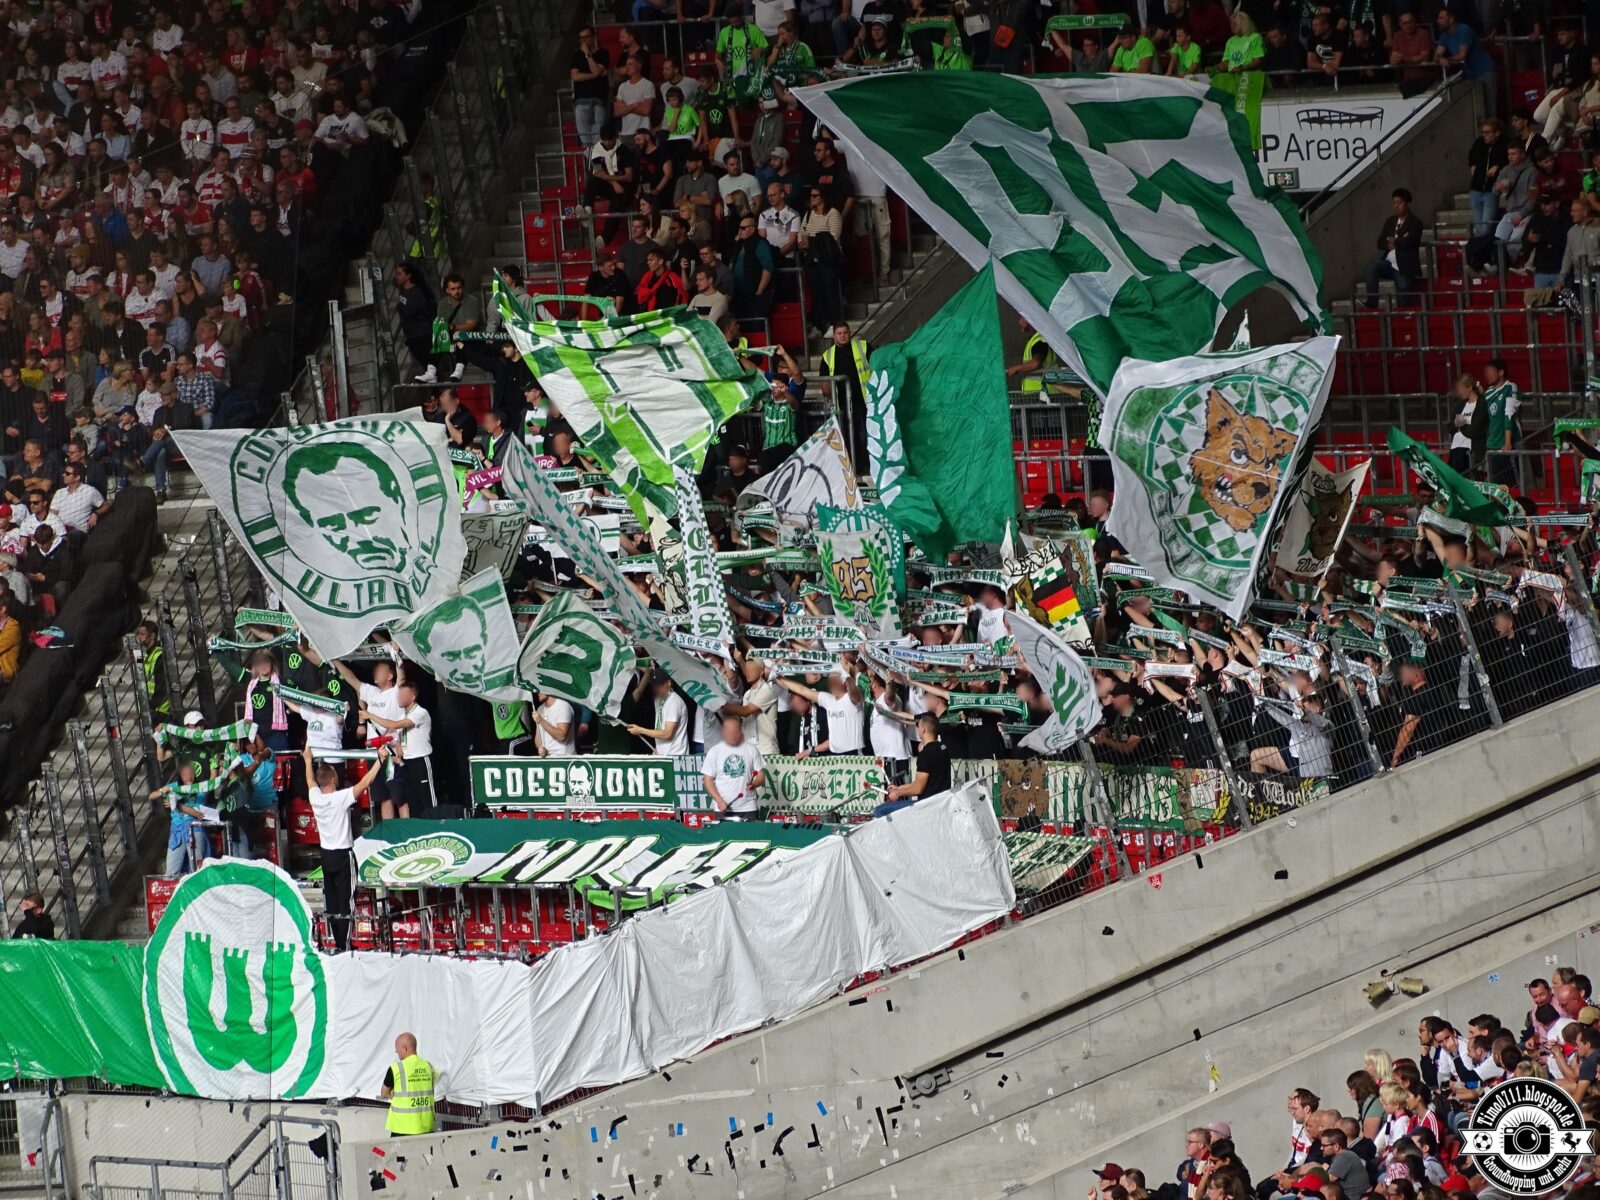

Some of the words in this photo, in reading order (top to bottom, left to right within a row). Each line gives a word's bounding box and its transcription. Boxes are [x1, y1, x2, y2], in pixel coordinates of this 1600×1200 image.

[1284, 133, 1367, 162] Arena
[832, 557, 877, 603] 95
[670, 634, 722, 651] ANGELS
[758, 766, 883, 803] NGELS
[411, 1097, 429, 1107] 2486
